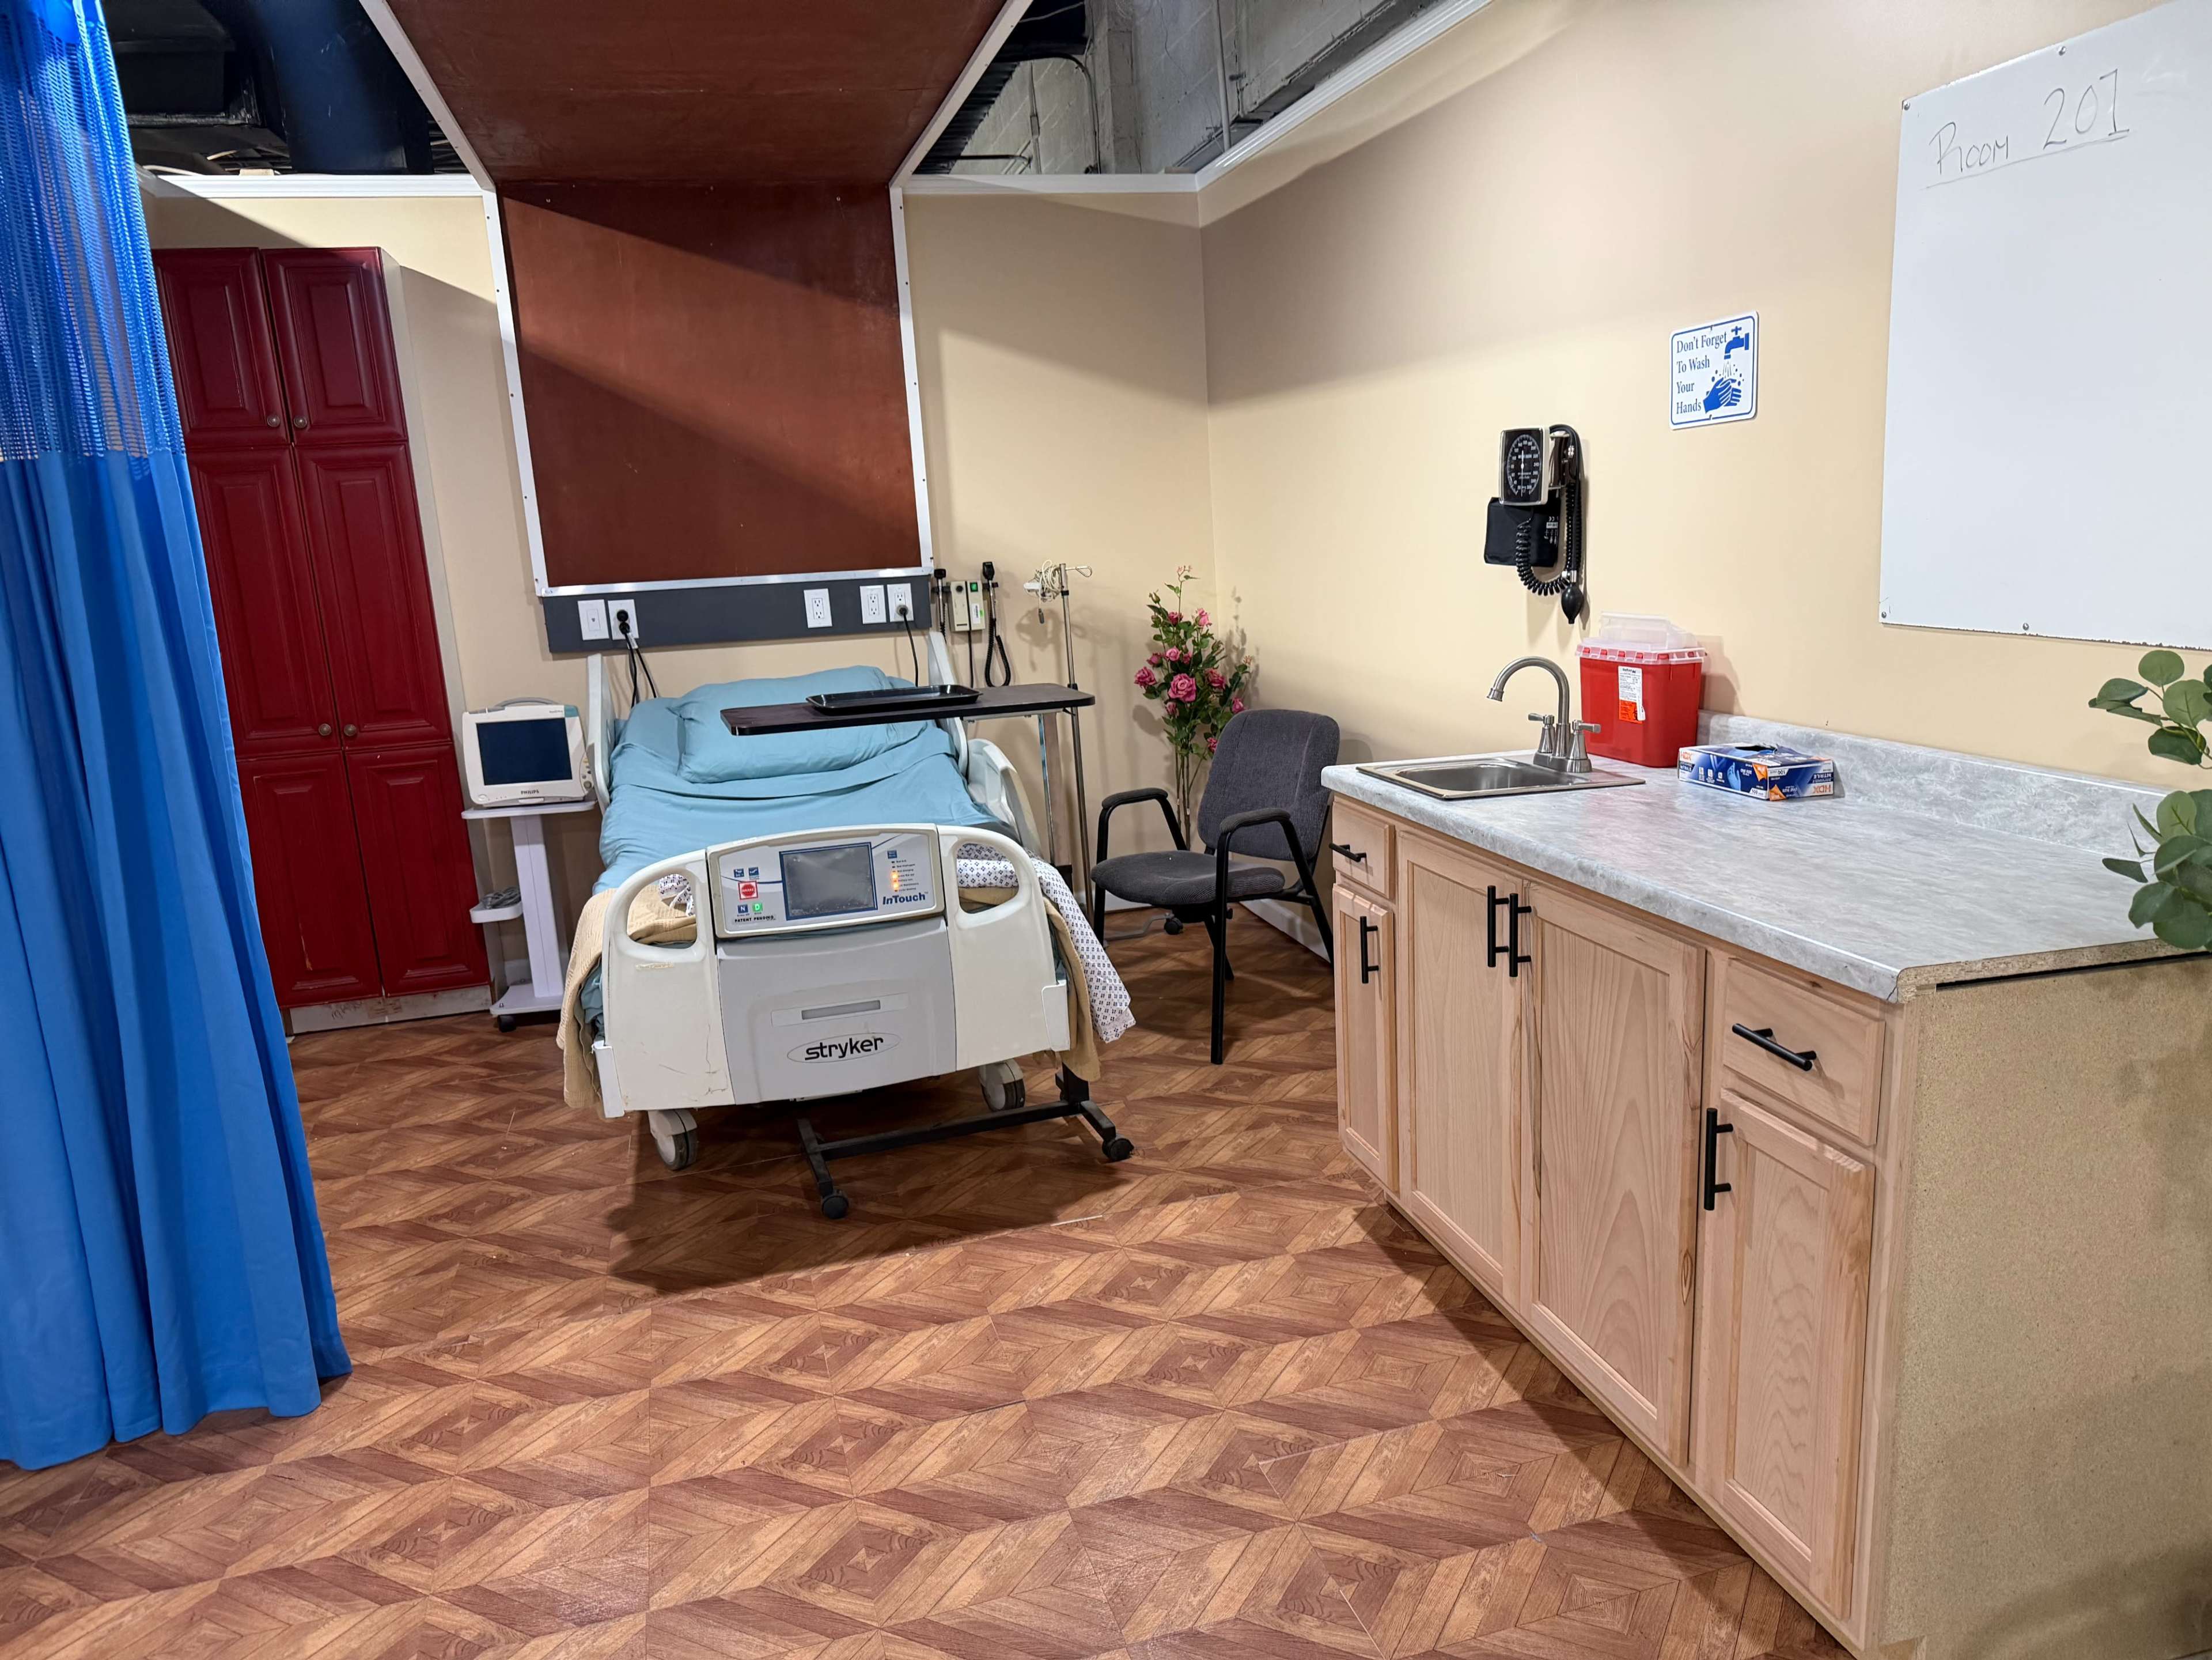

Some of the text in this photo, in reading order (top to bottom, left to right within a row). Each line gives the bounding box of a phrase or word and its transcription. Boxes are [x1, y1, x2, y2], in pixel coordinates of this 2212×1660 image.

[2043, 68, 2130, 150] 201
[1677, 331, 1727, 353] Don't Forget
[1676, 355, 1710, 373] To Wash
[1676, 381, 1695, 394] Your
[1676, 398, 1701, 414] Hands
[1813, 784, 1831, 793] HDX
[882, 892, 926, 905] InTouch
[805, 1037, 884, 1060] stryker
